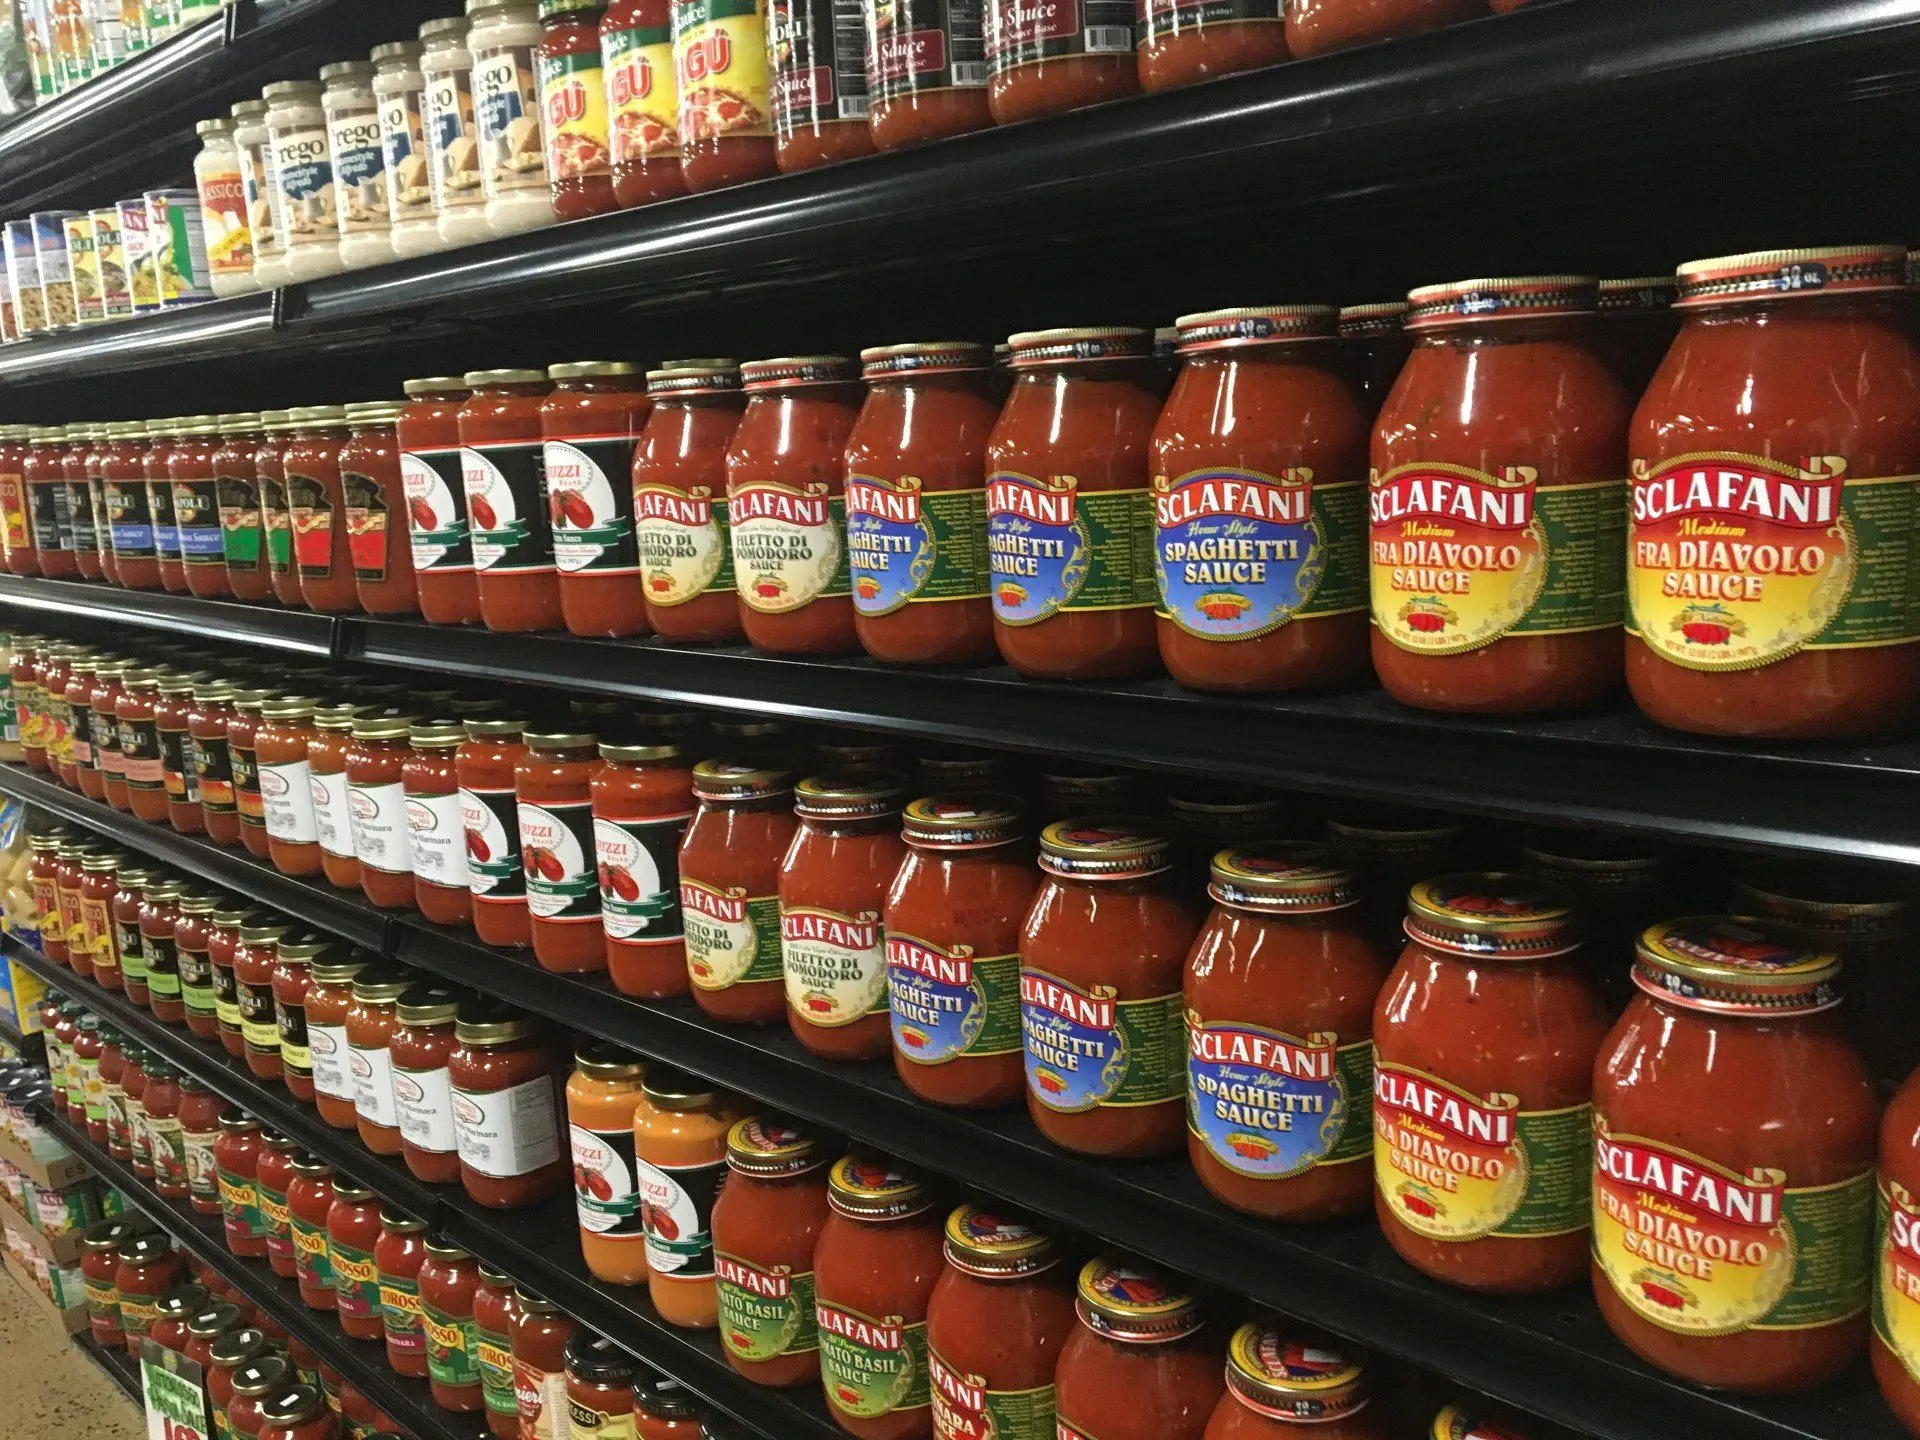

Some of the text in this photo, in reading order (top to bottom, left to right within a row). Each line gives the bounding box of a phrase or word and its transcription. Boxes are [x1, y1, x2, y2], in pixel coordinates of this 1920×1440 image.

[881, 38, 926, 60] Sauce
[333, 122, 381, 149] rego
[278, 139, 324, 164] rego
[204, 183, 244, 200] ASSICO
[546, 464, 581, 479] UZZI
[1157, 482, 1306, 525] SCLAFANI
[1371, 479, 1527, 525] SCLAFANI
[1634, 470, 1832, 524] SCLAFANI
[675, 533, 693, 546] DI
[1186, 518, 1259, 538] Home Style
[1400, 520, 1456, 538] Medium
[1676, 517, 1747, 538] Medium
[736, 546, 813, 560] POMODORO
[789, 534, 809, 547] DI
[1164, 537, 1300, 563] SPAGHETTI
[750, 559, 785, 571] SAUCE
[991, 554, 1039, 577] SAUCE
[1373, 540, 1522, 570] FRA DIAVOLO
[1636, 540, 1826, 573] FRA DIAVOLO
[1184, 562, 1267, 584] SAUCE
[1391, 569, 1471, 593] SAUCE
[1663, 572, 1764, 600] SAUCE
[714, 928, 729, 938] DI
[787, 959, 864, 981] POMODORO
[788, 949, 836, 968] FILETTO
[841, 958, 859, 969] DI
[801, 977, 836, 989] SAUCE
[893, 998, 939, 1027] SAUCE
[1028, 1039, 1079, 1072] SAUCE
[1191, 1029, 1331, 1078] SCLAFANI
[1218, 1065, 1286, 1089] Home Style
[1197, 1073, 1323, 1113] SPAGHETTI
[1215, 1100, 1293, 1132] SAUCE
[1397, 1112, 1446, 1142] Medium
[465, 1124, 498, 1139] Marinara
[1399, 1129, 1505, 1181] DIAVOLO
[1389, 1149, 1458, 1192] SAUCE
[1597, 1138, 1773, 1224] SCLAFANI
[1635, 1190, 1698, 1223] Medium
[1599, 1187, 1768, 1266] FRA DIAVOLO
[1623, 1230, 1713, 1280] SAUCE
[722, 1308, 761, 1332] SAUCE
[745, 1302, 786, 1321] BASIL
[827, 1360, 871, 1387] SAUCE
[854, 1354, 899, 1374] BASIL
[932, 1395, 978, 1438] NARA
